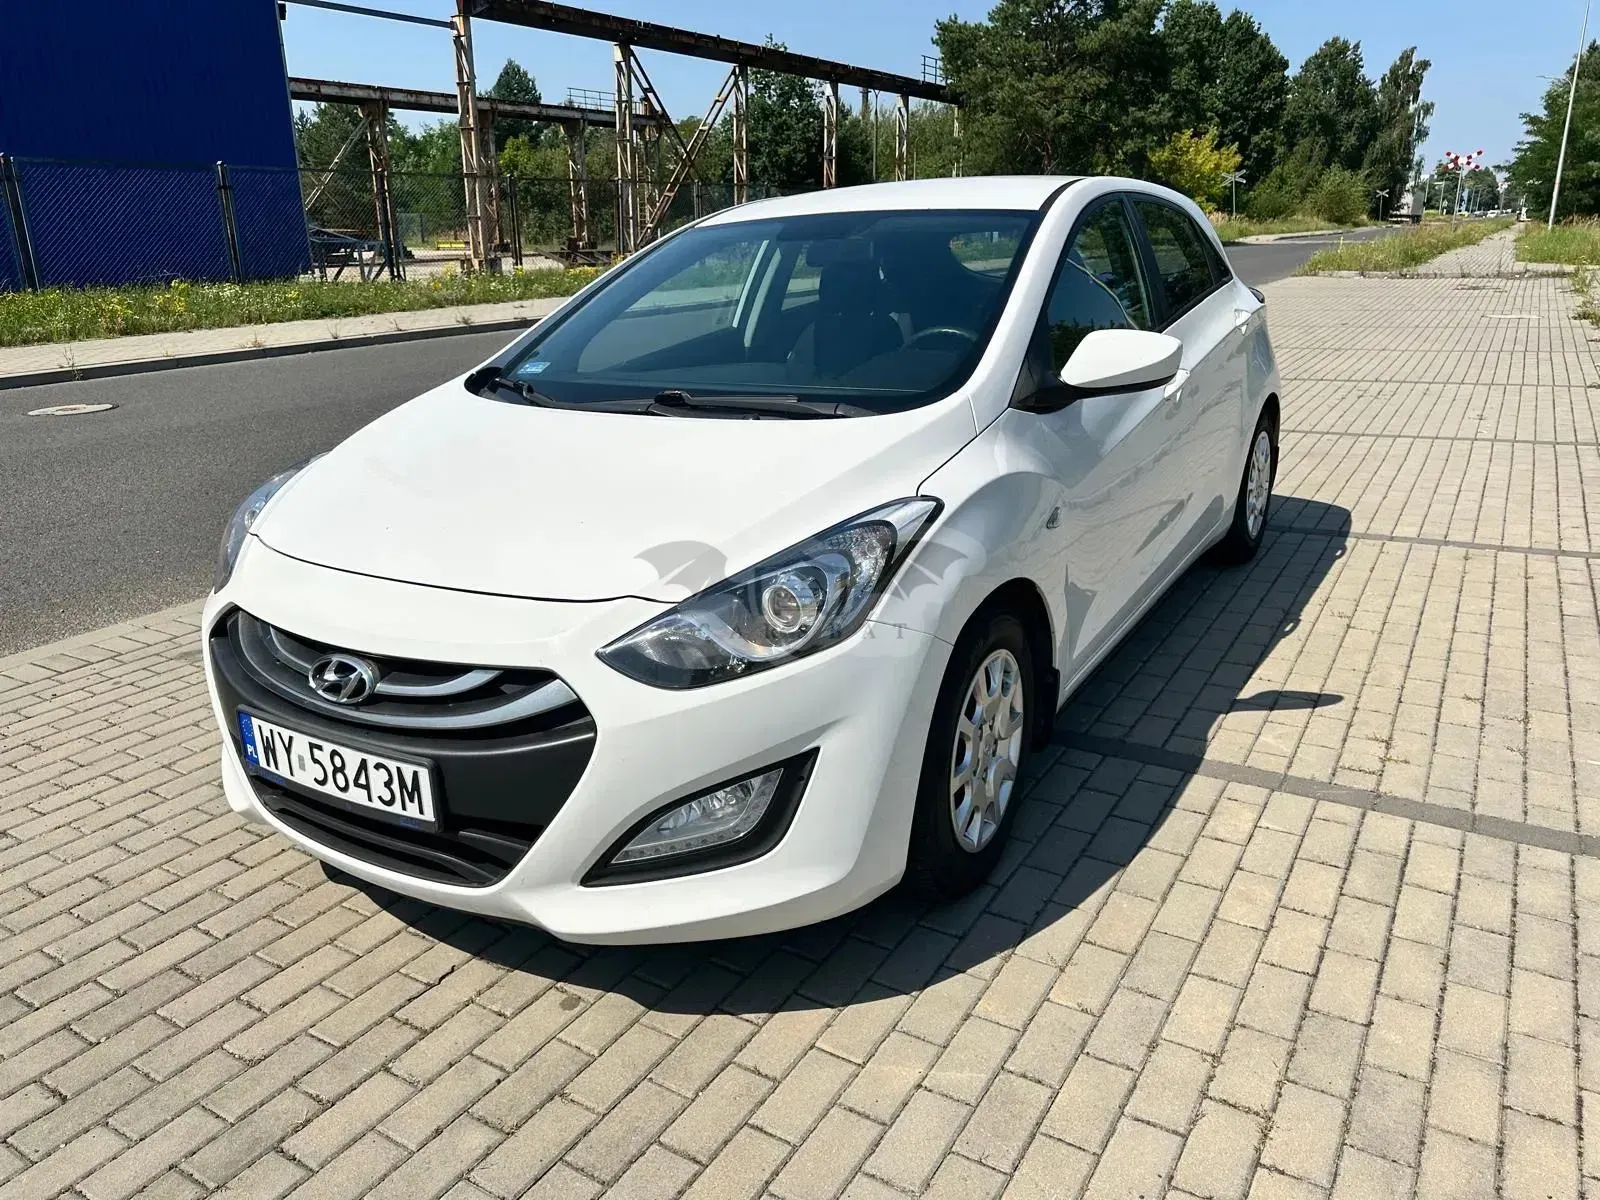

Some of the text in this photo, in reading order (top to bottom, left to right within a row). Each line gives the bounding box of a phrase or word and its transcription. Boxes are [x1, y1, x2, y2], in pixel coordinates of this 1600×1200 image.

[246, 743, 258, 759] PL
[257, 724, 425, 816] WY 5843M
